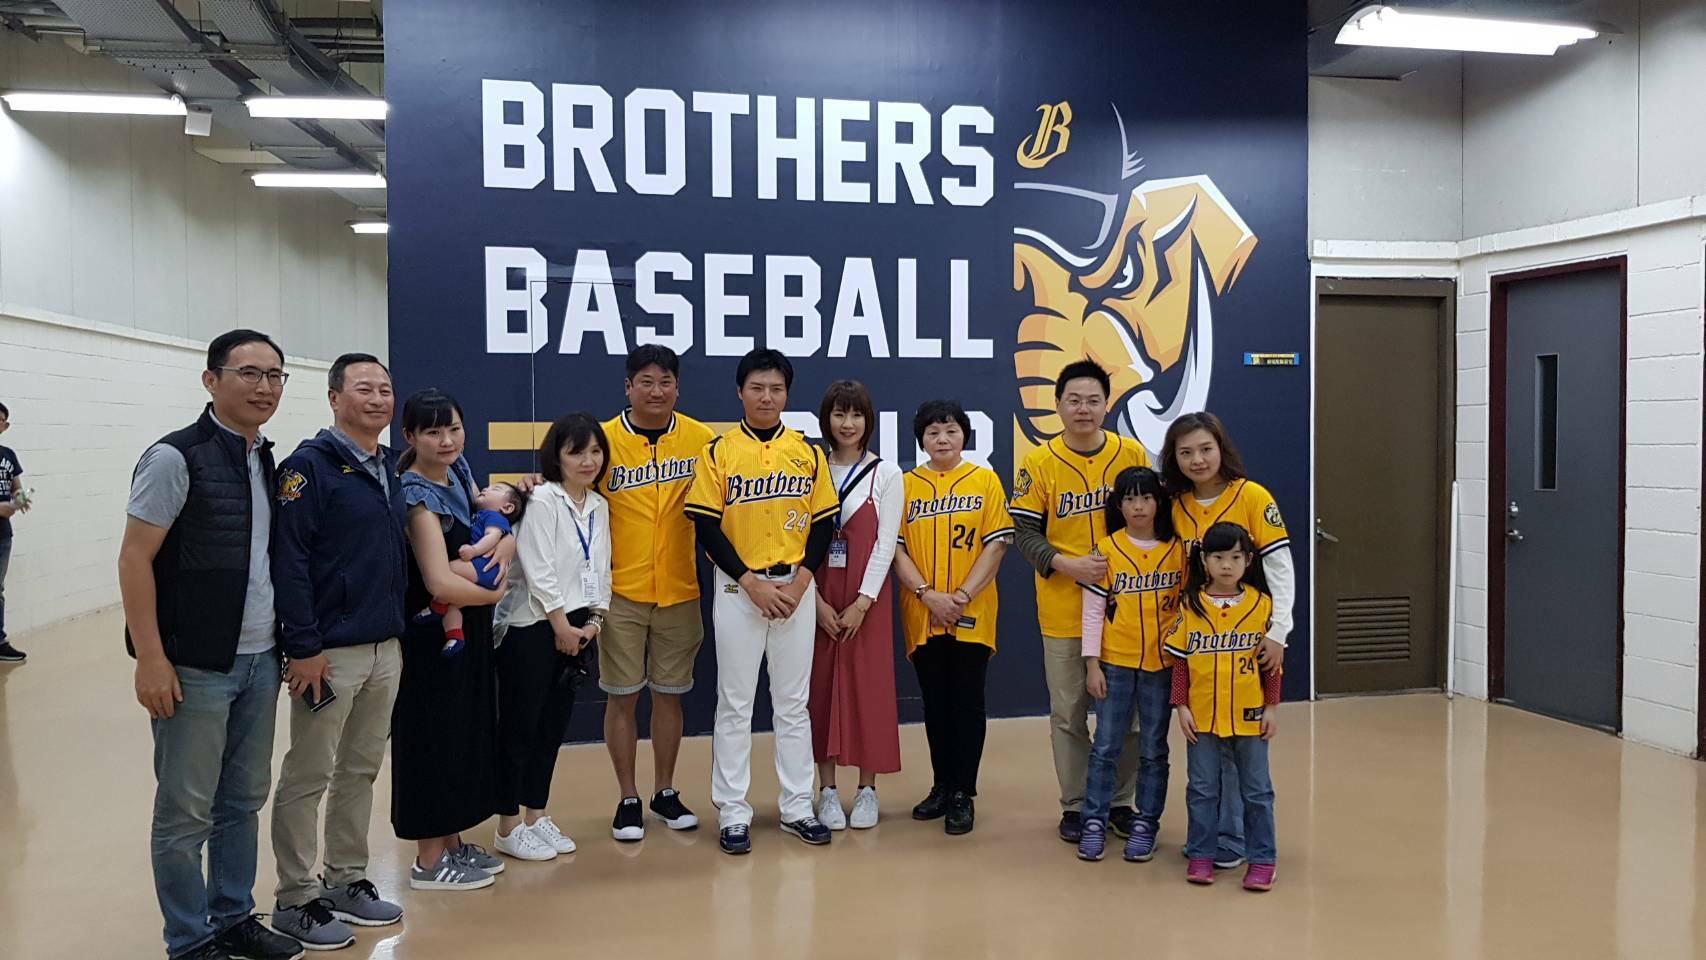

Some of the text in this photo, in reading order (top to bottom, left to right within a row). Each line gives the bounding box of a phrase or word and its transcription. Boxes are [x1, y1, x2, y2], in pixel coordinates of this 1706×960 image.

[482, 79, 995, 207] BROTHERS
[484, 245, 995, 359] BASEBALL
[725, 470, 814, 506] Brothers
[784, 510, 810, 533] 24
[906, 492, 984, 524] Brothers
[952, 524, 976, 552] 24
[1112, 568, 1183, 595] Brothers
[1185, 628, 1264, 655] Brothers
[1239, 655, 1255, 675] 24
